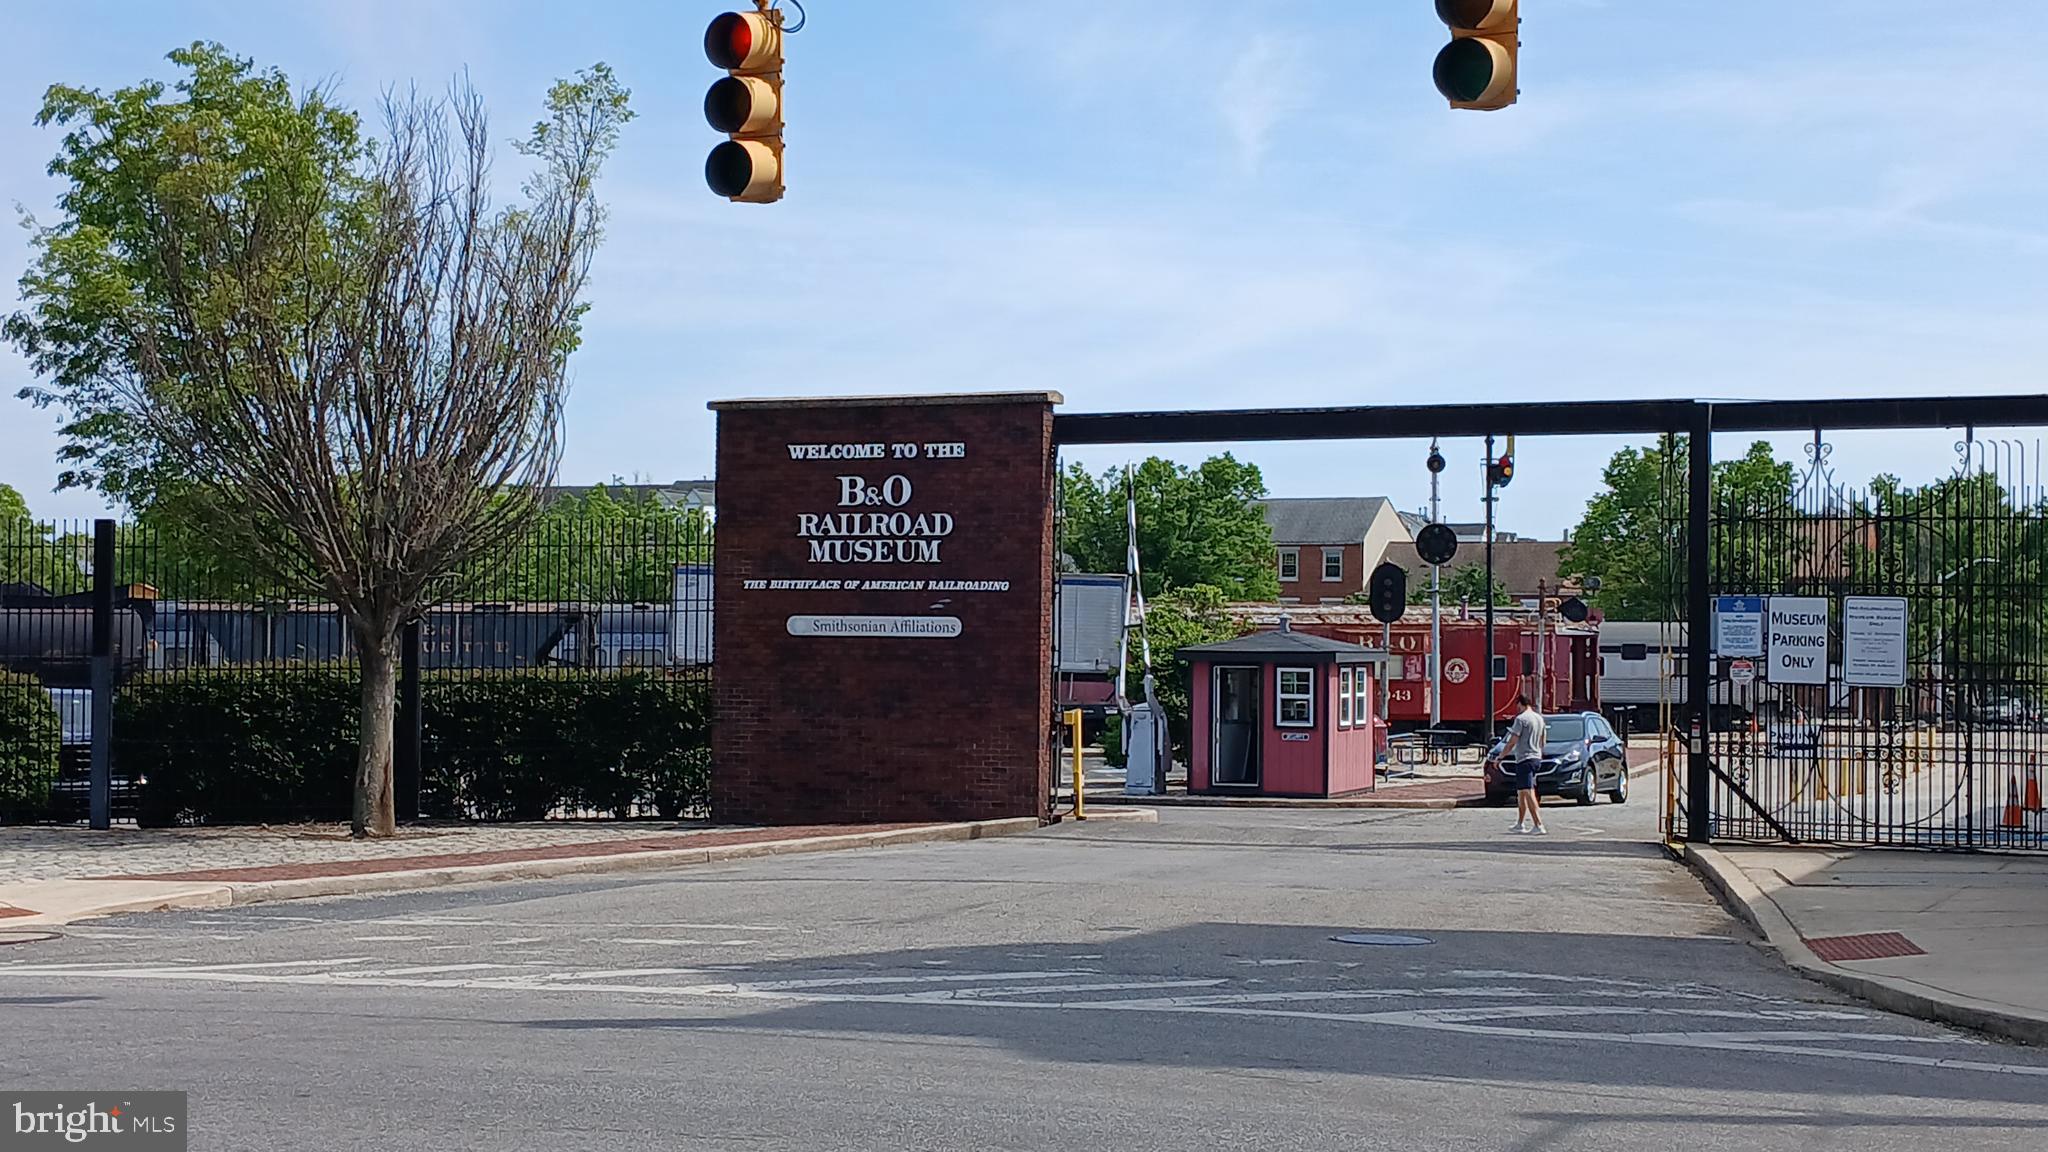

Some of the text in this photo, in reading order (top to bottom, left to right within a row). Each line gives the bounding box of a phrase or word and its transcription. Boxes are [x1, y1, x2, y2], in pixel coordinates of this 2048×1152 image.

[787, 442, 965, 459] WELCOME TO THE
[836, 474, 912, 506] B&O
[797, 512, 953, 536] RAILROAD
[808, 539, 942, 562] MUSEUM
[743, 580, 1010, 591] THE BIRTHPLACE OF AMERICAN RAILROADING
[1771, 611, 1826, 626] MUSEUM
[812, 619, 956, 634] Smithsonian Affiliations
[1772, 632, 1825, 647] PARKING
[1782, 654, 1815, 669] ONLY
